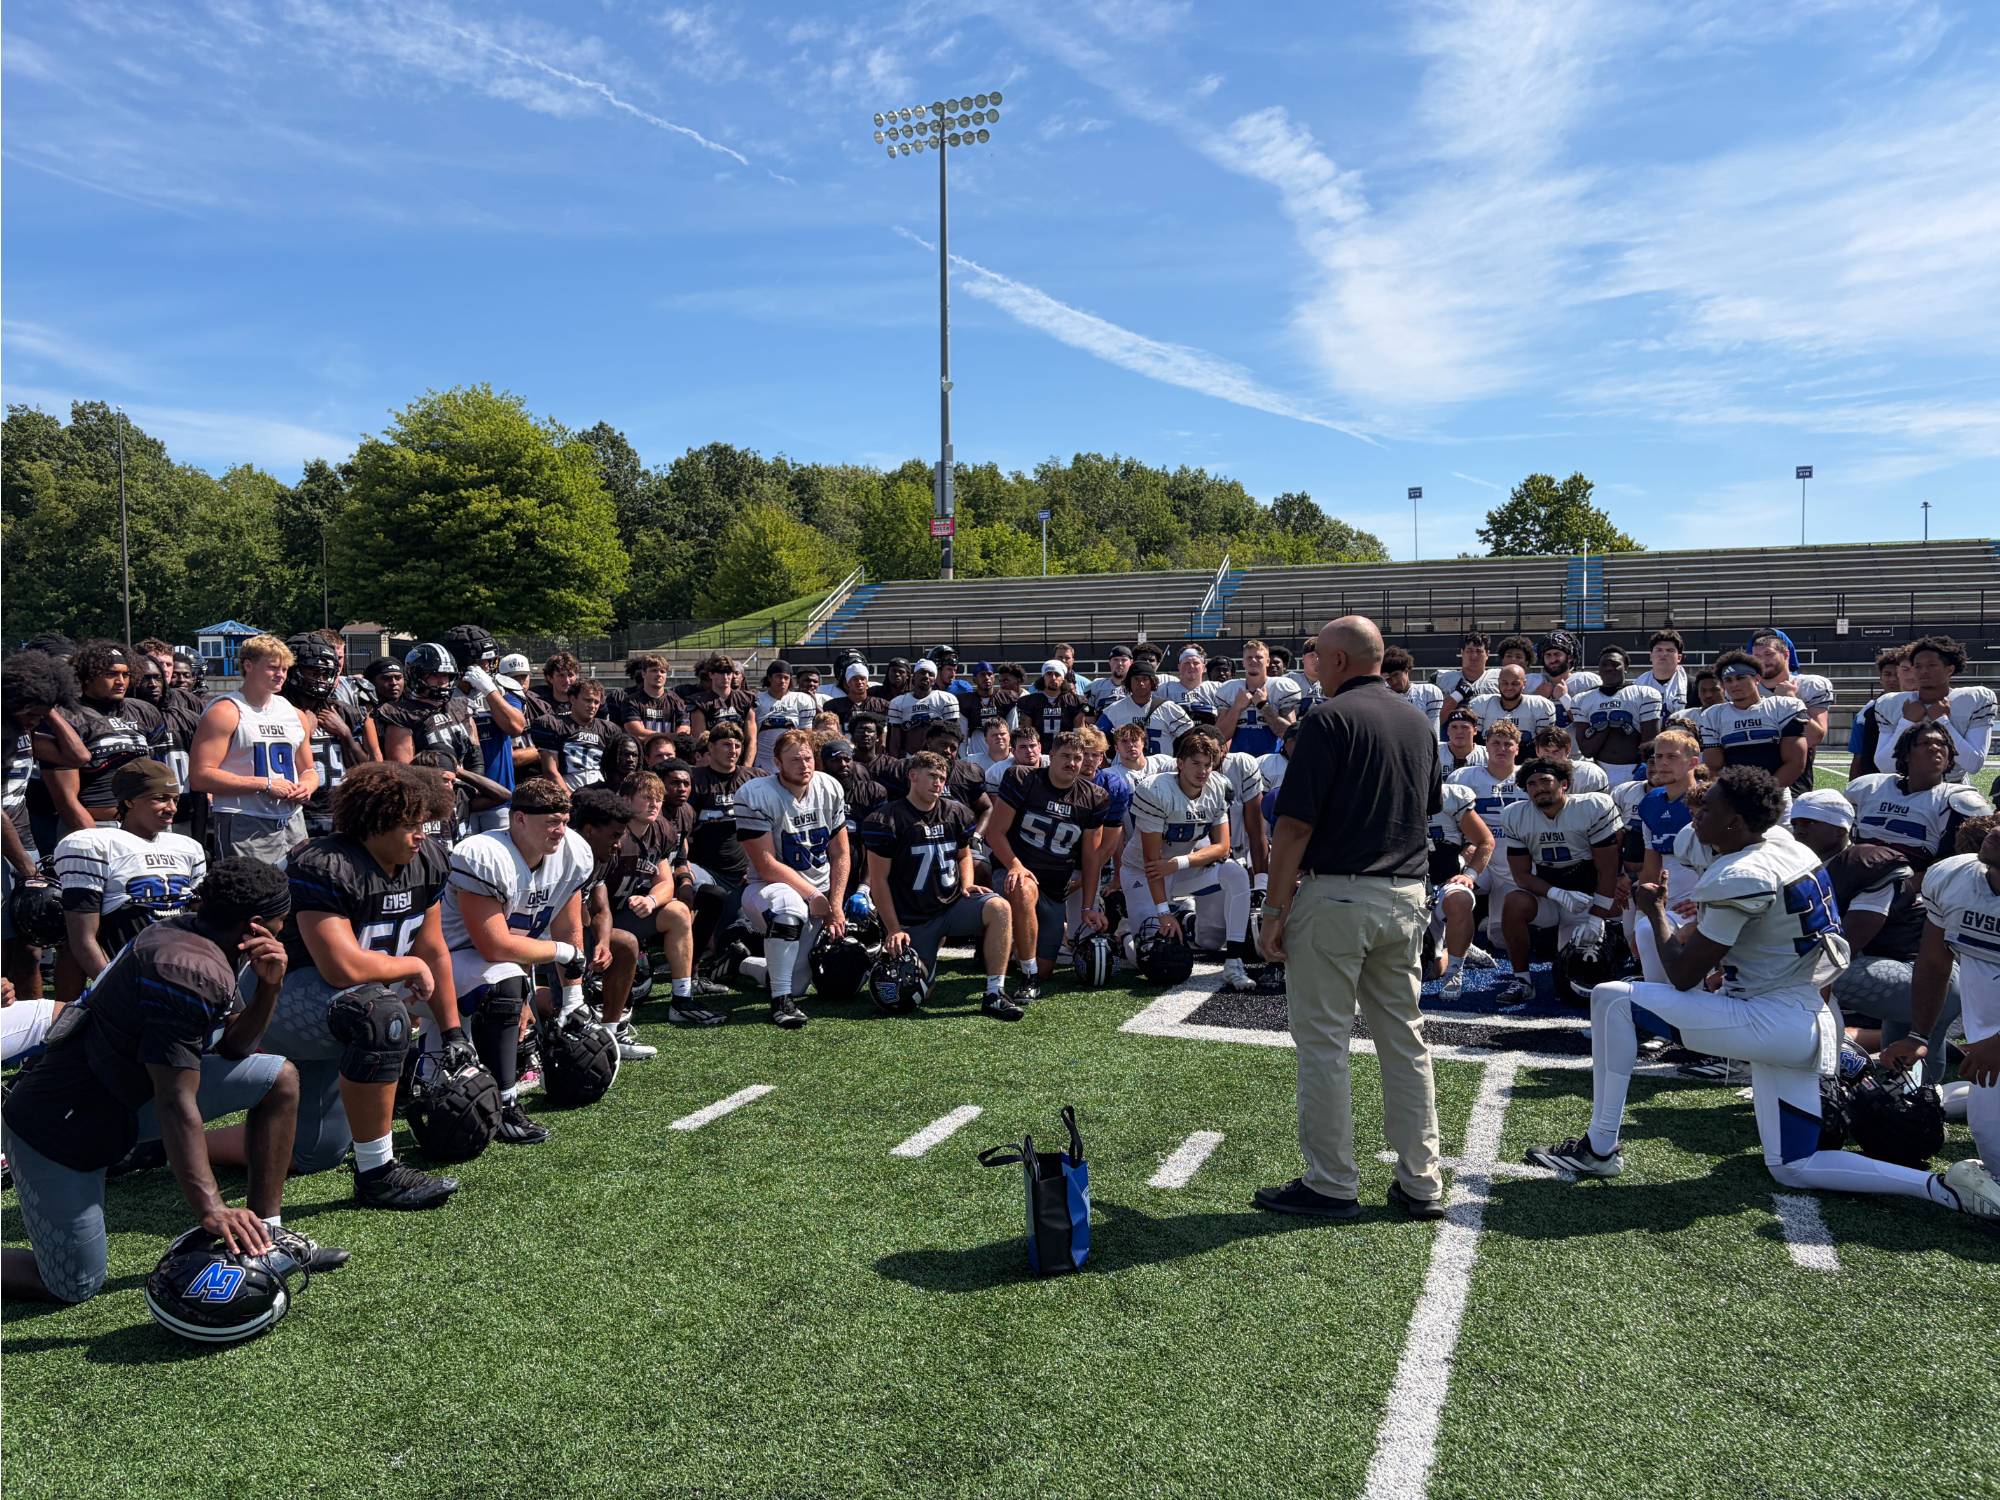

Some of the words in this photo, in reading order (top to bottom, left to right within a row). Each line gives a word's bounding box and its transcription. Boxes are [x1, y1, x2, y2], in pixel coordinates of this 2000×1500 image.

[257, 725, 286, 736] GVSU
[1733, 719, 1762, 729] GVSU
[252, 741, 293, 785] 19
[1046, 800, 1072, 815] GVSU
[1878, 801, 1910, 815] GVSU
[793, 811, 818, 826] GVSU
[1019, 811, 1082, 855] 50
[145, 854, 176, 866] GVSU
[910, 841, 958, 892] 75
